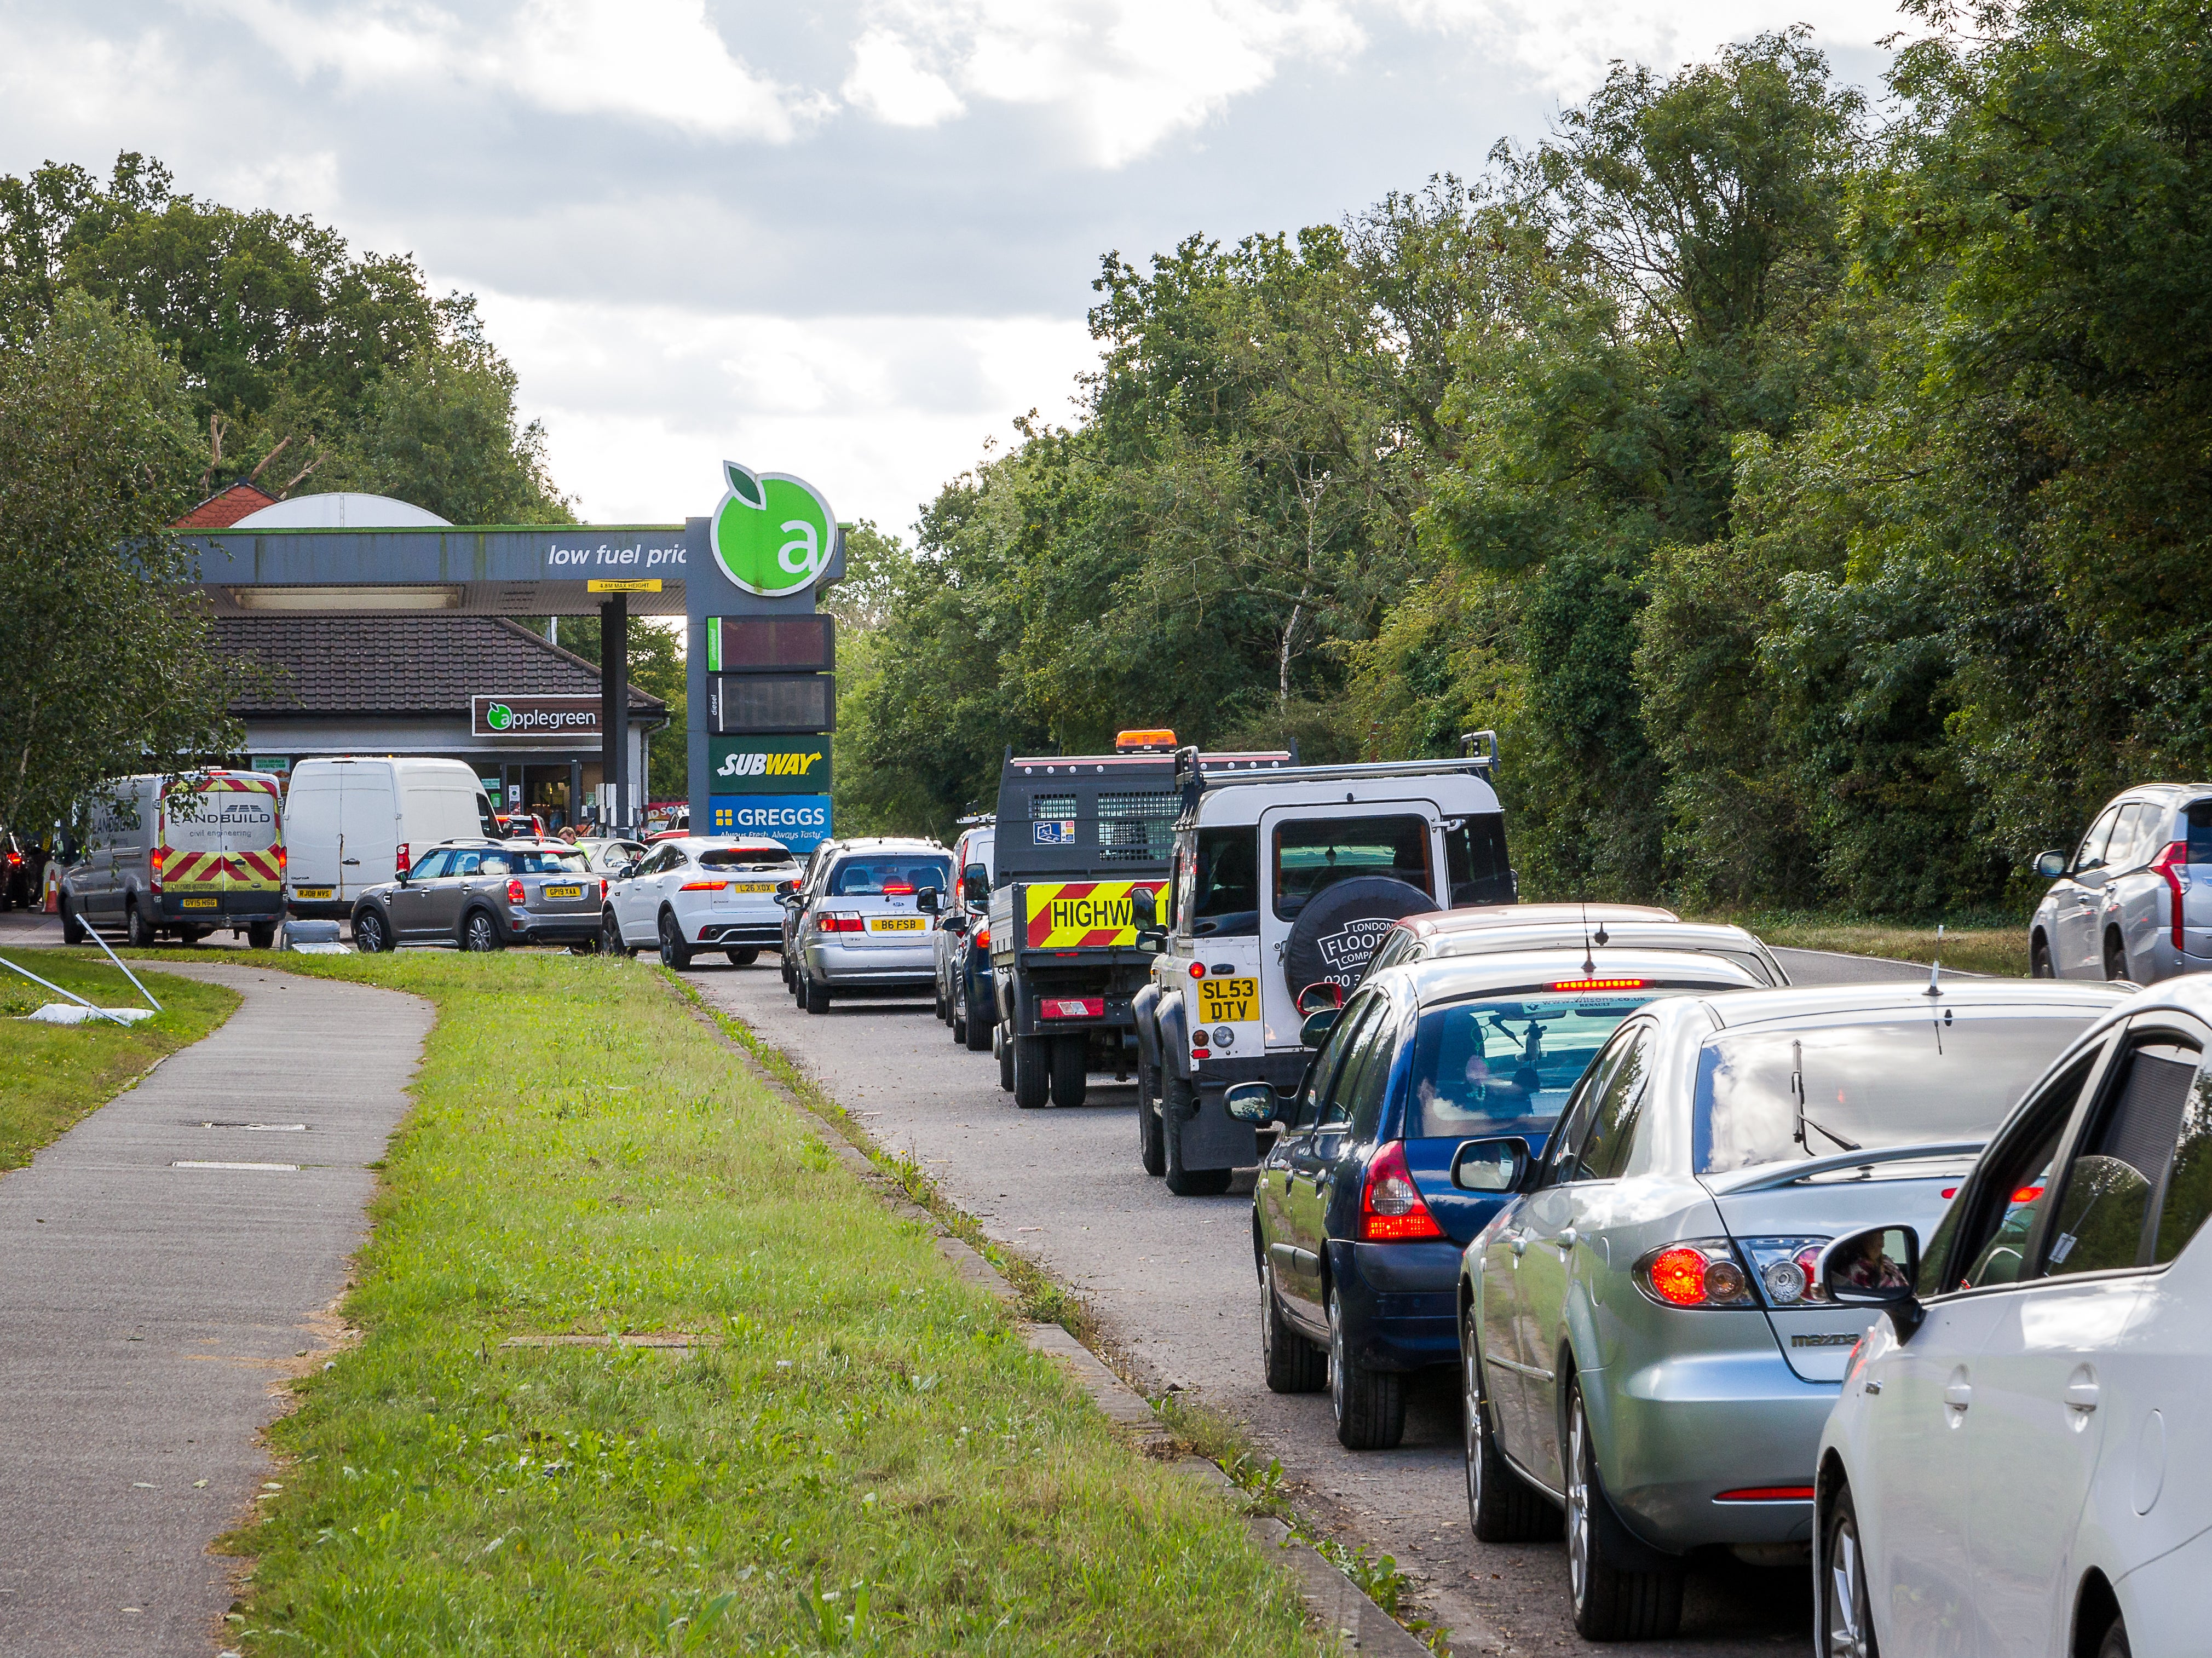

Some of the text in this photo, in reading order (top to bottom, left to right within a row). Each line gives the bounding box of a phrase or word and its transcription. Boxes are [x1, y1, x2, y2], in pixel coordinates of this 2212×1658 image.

[548, 545, 590, 565] low
[596, 544, 642, 565] fuel
[500, 709, 596, 729] applegreen
[717, 751, 822, 776] SUBWAY
[738, 808, 825, 826] GREGGS
[771, 830, 799, 840] Always
[1053, 900, 1157, 928] HIGHW
[882, 920, 916, 929] B6 FSB
[1352, 922, 1393, 932] LONDON
[1203, 980, 1254, 999] SL53
[1210, 1000, 1248, 1020] DTV
[1542, 996, 1646, 1006] www.wilsons.co.uk
